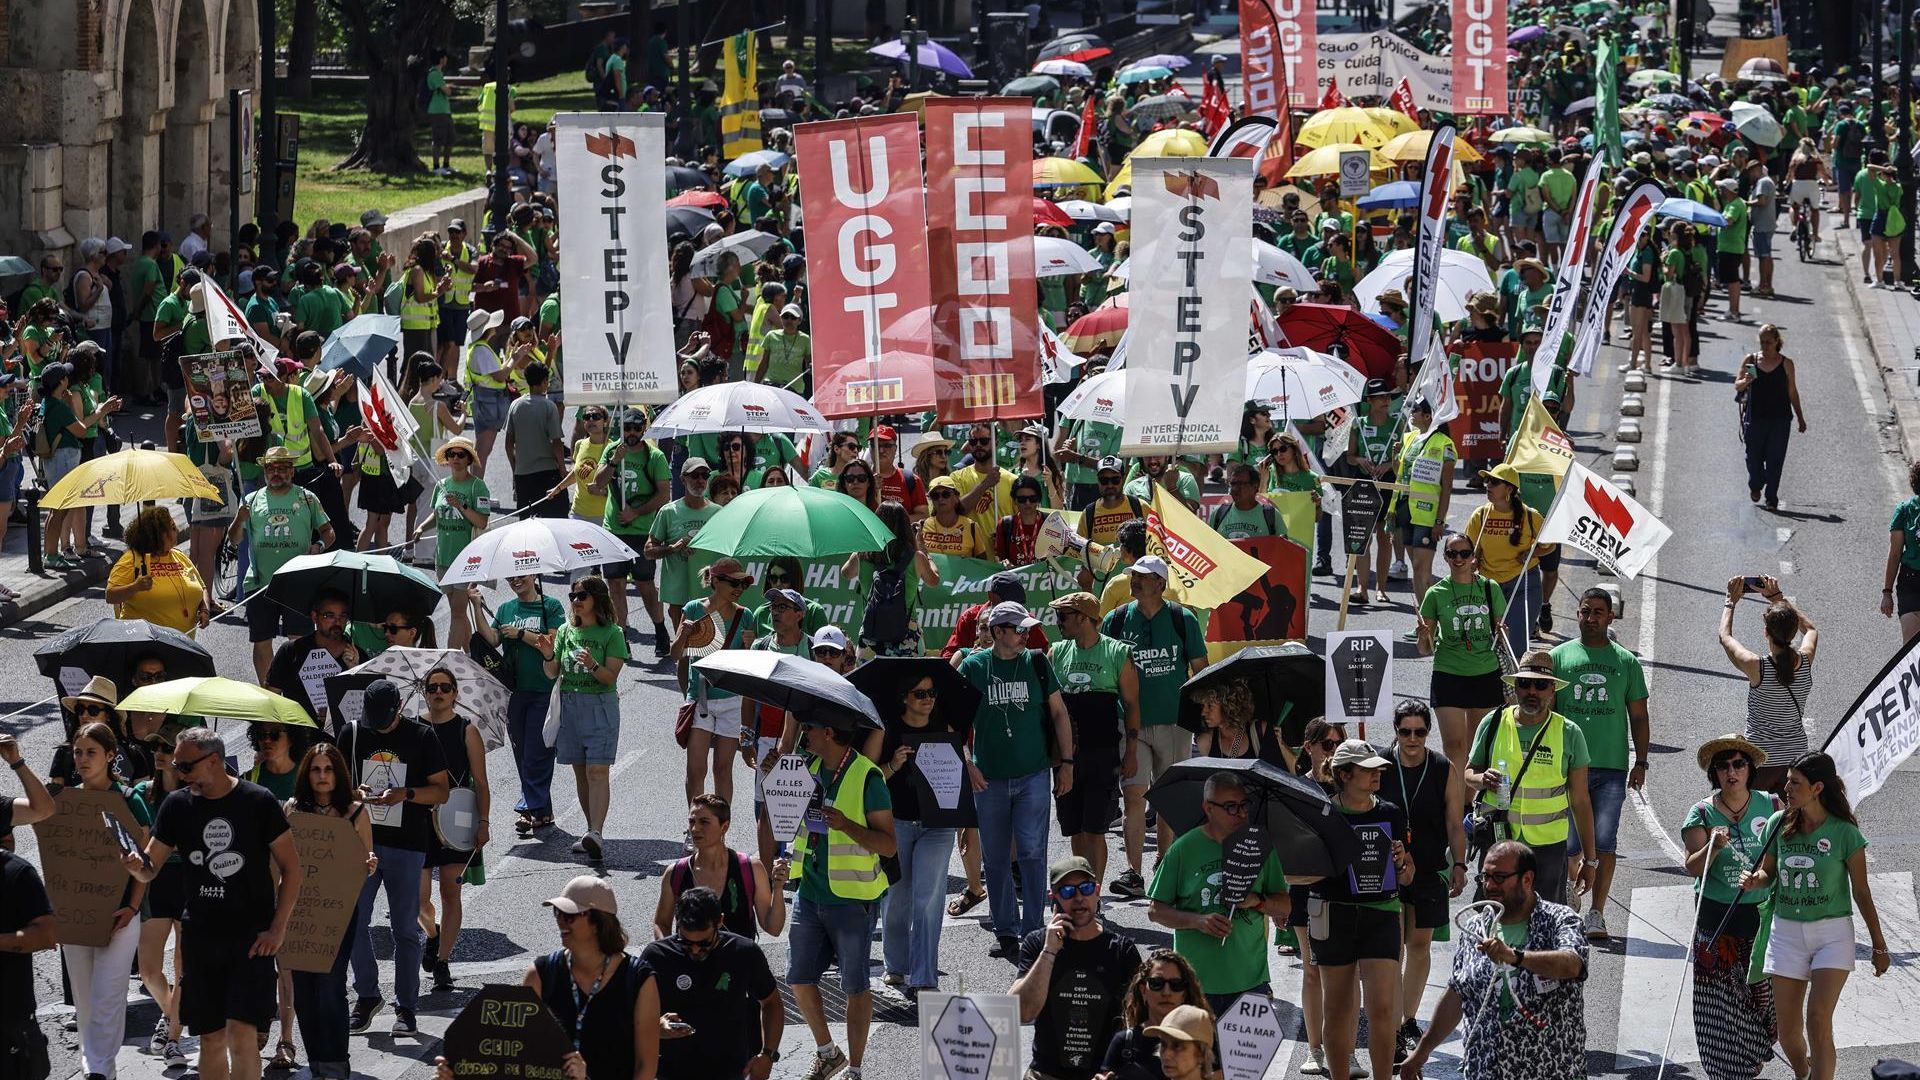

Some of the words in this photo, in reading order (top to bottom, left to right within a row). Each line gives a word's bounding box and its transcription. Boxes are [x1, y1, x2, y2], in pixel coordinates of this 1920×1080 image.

[1371, 35, 1420, 62] Pública
[1466, 0, 1493, 91] UGT
[1318, 58, 1335, 69] es
[1345, 54, 1381, 69] cuida
[1348, 72, 1394, 88] retalla
[828, 135, 898, 363] UGT
[600, 165, 632, 366] STEPV
[1419, 223, 1433, 309] STEPV
[1588, 251, 1613, 329] STEPV
[1547, 276, 1572, 332] EPV
[1170, 206, 1205, 418] STEPV
[582, 371, 659, 381] INTERSINDICAL
[595, 381, 659, 391] VALENCIANA
[1141, 423, 1222, 434] INTERSINDICAL
[1153, 433, 1220, 443] VALENCIANA
[1574, 515, 1631, 560] STEPV
[578, 548, 600, 557] STEPV
[463, 564, 480, 572] STEPV
[514, 557, 541, 566] STEPV
[804, 563, 843, 589] HA
[1351, 639, 1374, 651] RIP
[311, 651, 327, 660] RIP
[1132, 647, 1170, 661] CRIDA
[317, 663, 338, 671] SERRA
[988, 684, 998, 702] LA
[998, 681, 1030, 700] LLENGUA
[780, 758, 804, 771] RIP
[765, 789, 812, 798] RONDALLES
[1361, 831, 1379, 840] RIP
[213, 858, 240, 870] Qualitat
[480, 1000, 539, 1028] RIP
[1240, 1001, 1269, 1018] RIP
[1223, 1022, 1238, 1032] IES
[1239, 1025, 1252, 1034] LA
[1253, 1027, 1276, 1038] MAR
[479, 1038, 524, 1057] CEIP
